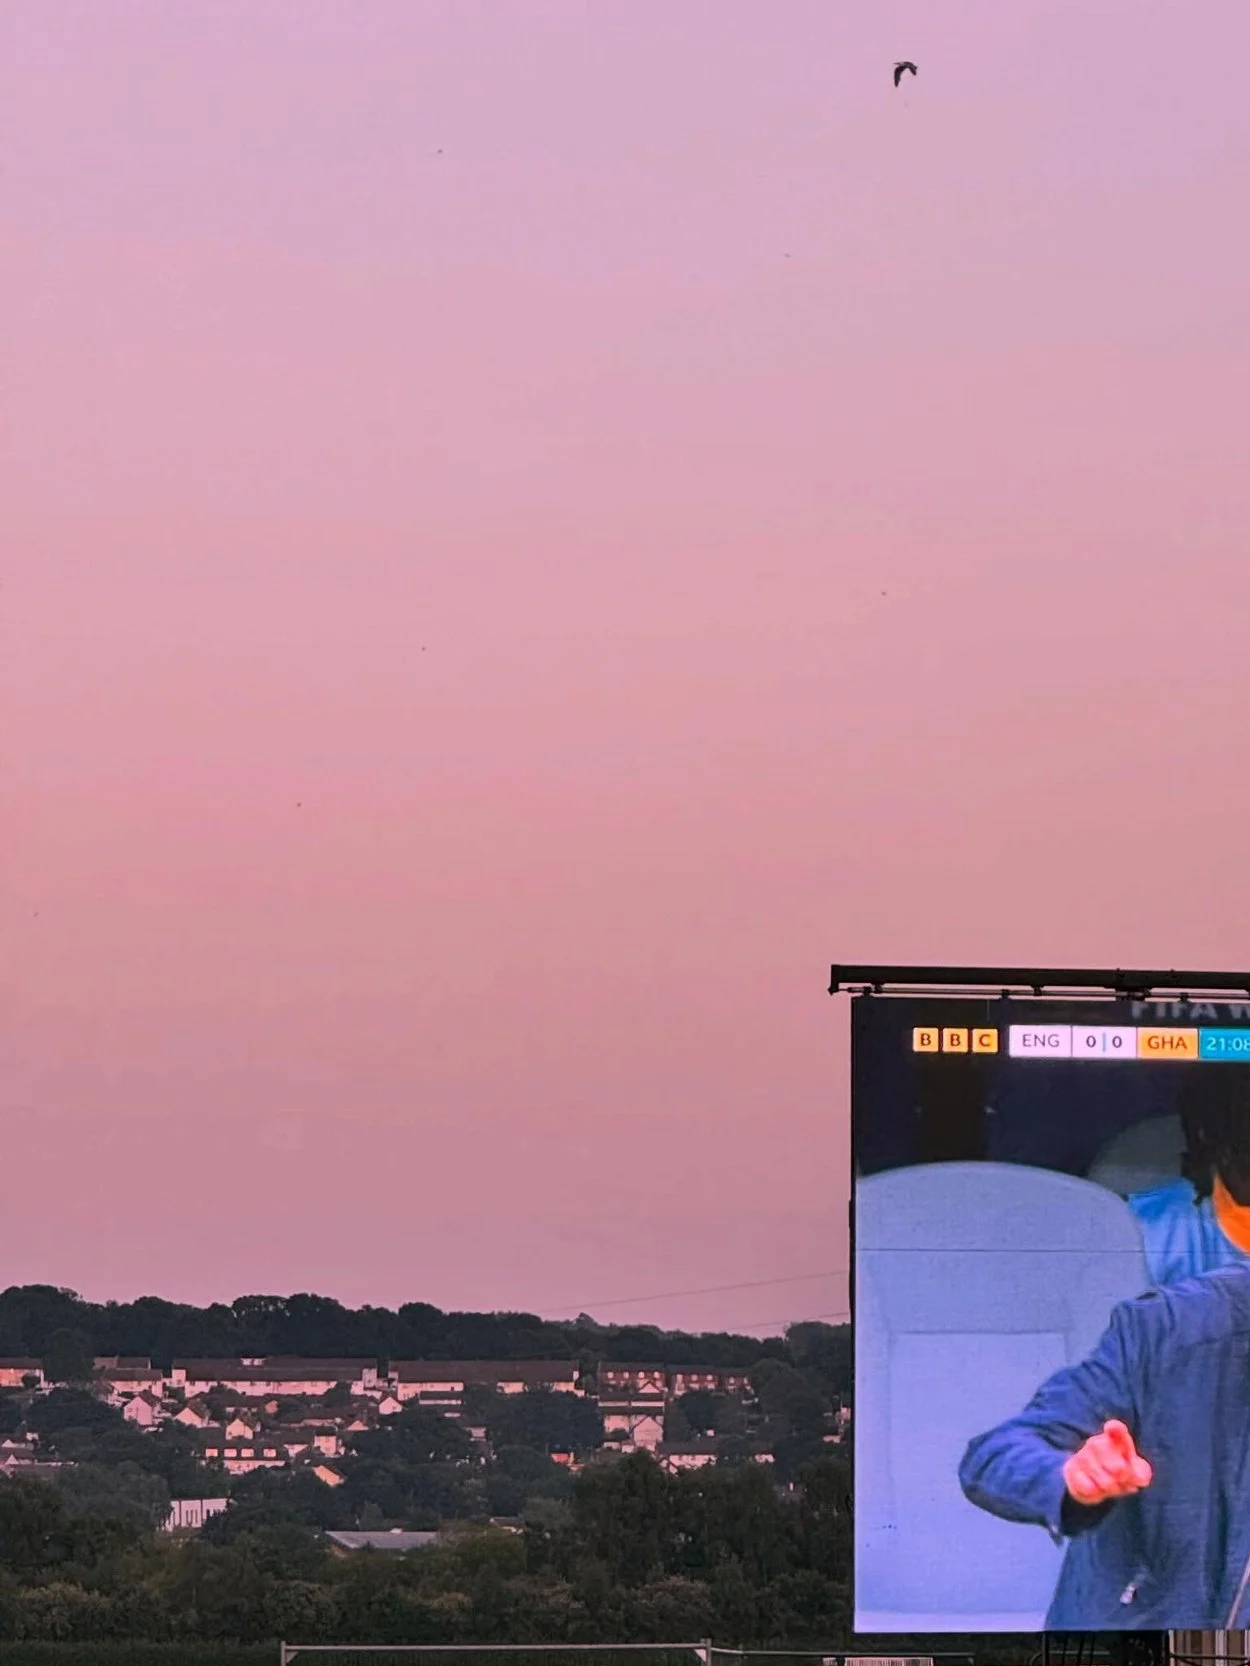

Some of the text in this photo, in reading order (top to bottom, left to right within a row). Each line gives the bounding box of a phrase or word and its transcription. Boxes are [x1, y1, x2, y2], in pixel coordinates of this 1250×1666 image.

[1131, 1002, 1218, 1020] FIFA
[1022, 1034, 1060, 1048] ENG
[1086, 1035, 1097, 1049] 0
[1112, 1036, 1123, 1050] 0
[1146, 1035, 1188, 1050] GHA
